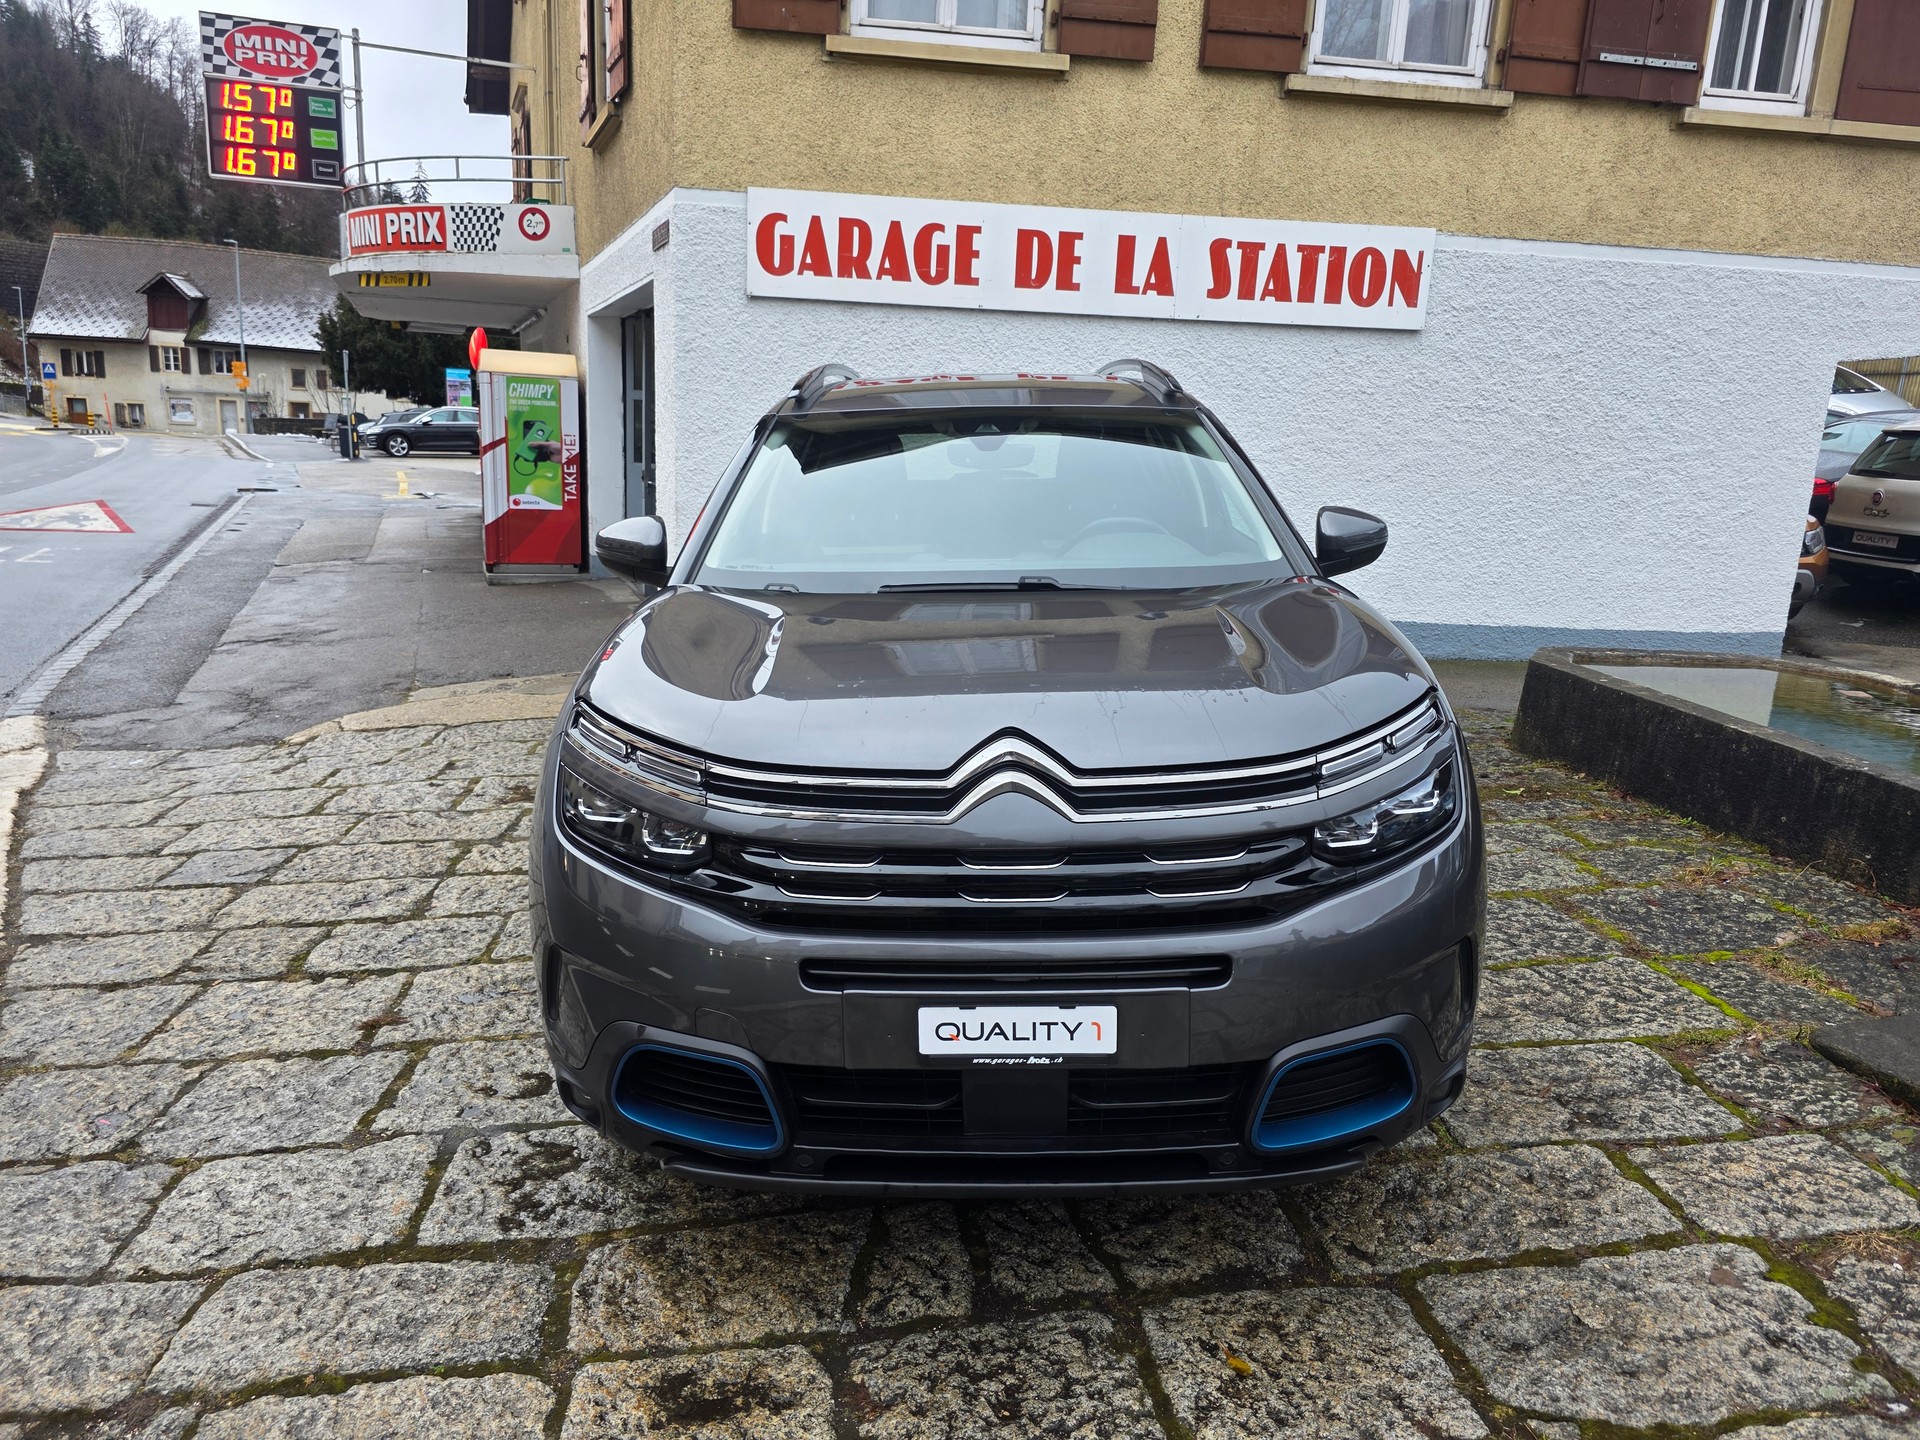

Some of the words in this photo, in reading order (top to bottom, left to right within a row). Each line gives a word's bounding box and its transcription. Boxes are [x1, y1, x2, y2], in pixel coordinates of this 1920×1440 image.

[234, 32, 308, 55] MINI
[235, 48, 309, 70] PRIX
[350, 214, 382, 248] MINI
[385, 211, 443, 244] PRIX
[755, 212, 982, 286] GARAGE
[1014, 228, 1084, 292] DE
[1114, 234, 1175, 297] LA
[1206, 237, 1424, 308] STATION
[509, 382, 555, 399] CHIMPY
[564, 434, 577, 461] ME!
[564, 464, 577, 502] TAKE
[1855, 534, 1892, 545] QUALITY
[935, 1022, 1083, 1041] QUALITY
[1091, 1022, 1102, 1041] 1
